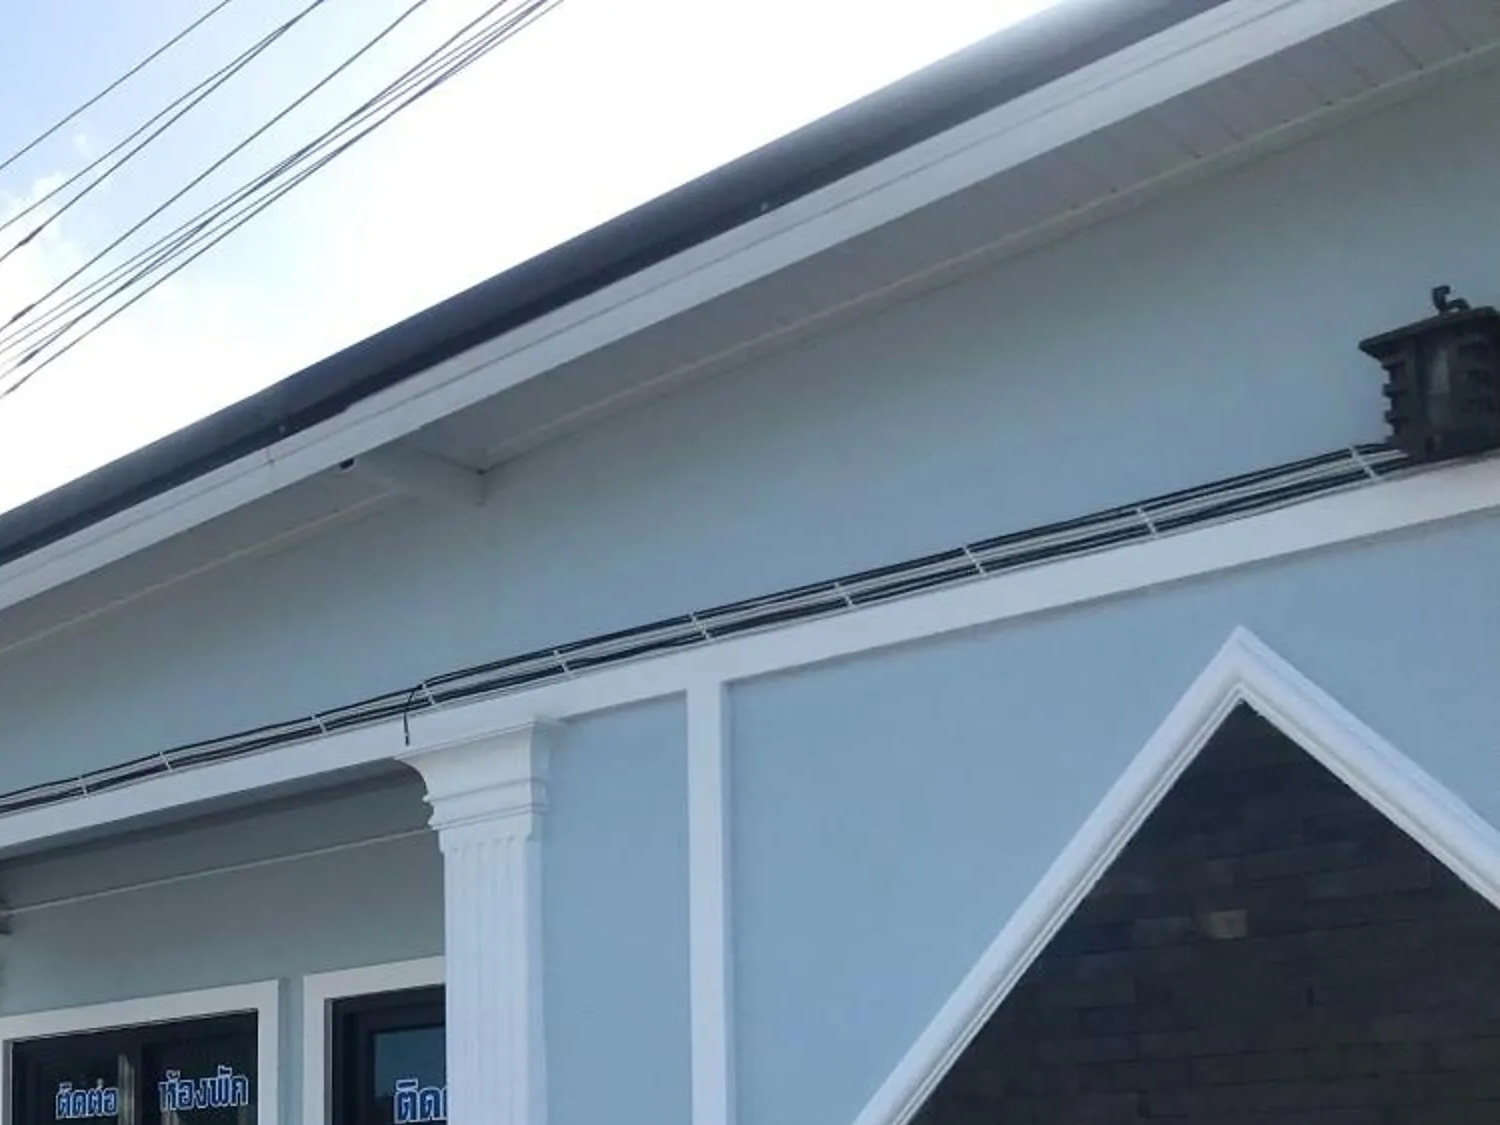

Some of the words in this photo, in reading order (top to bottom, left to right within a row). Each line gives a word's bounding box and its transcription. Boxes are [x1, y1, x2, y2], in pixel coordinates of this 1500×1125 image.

[55, 1078, 119, 1120] ติดต่อ
[158, 1065, 250, 1113] ห้องพัก
[394, 1077, 447, 1125] ติด
